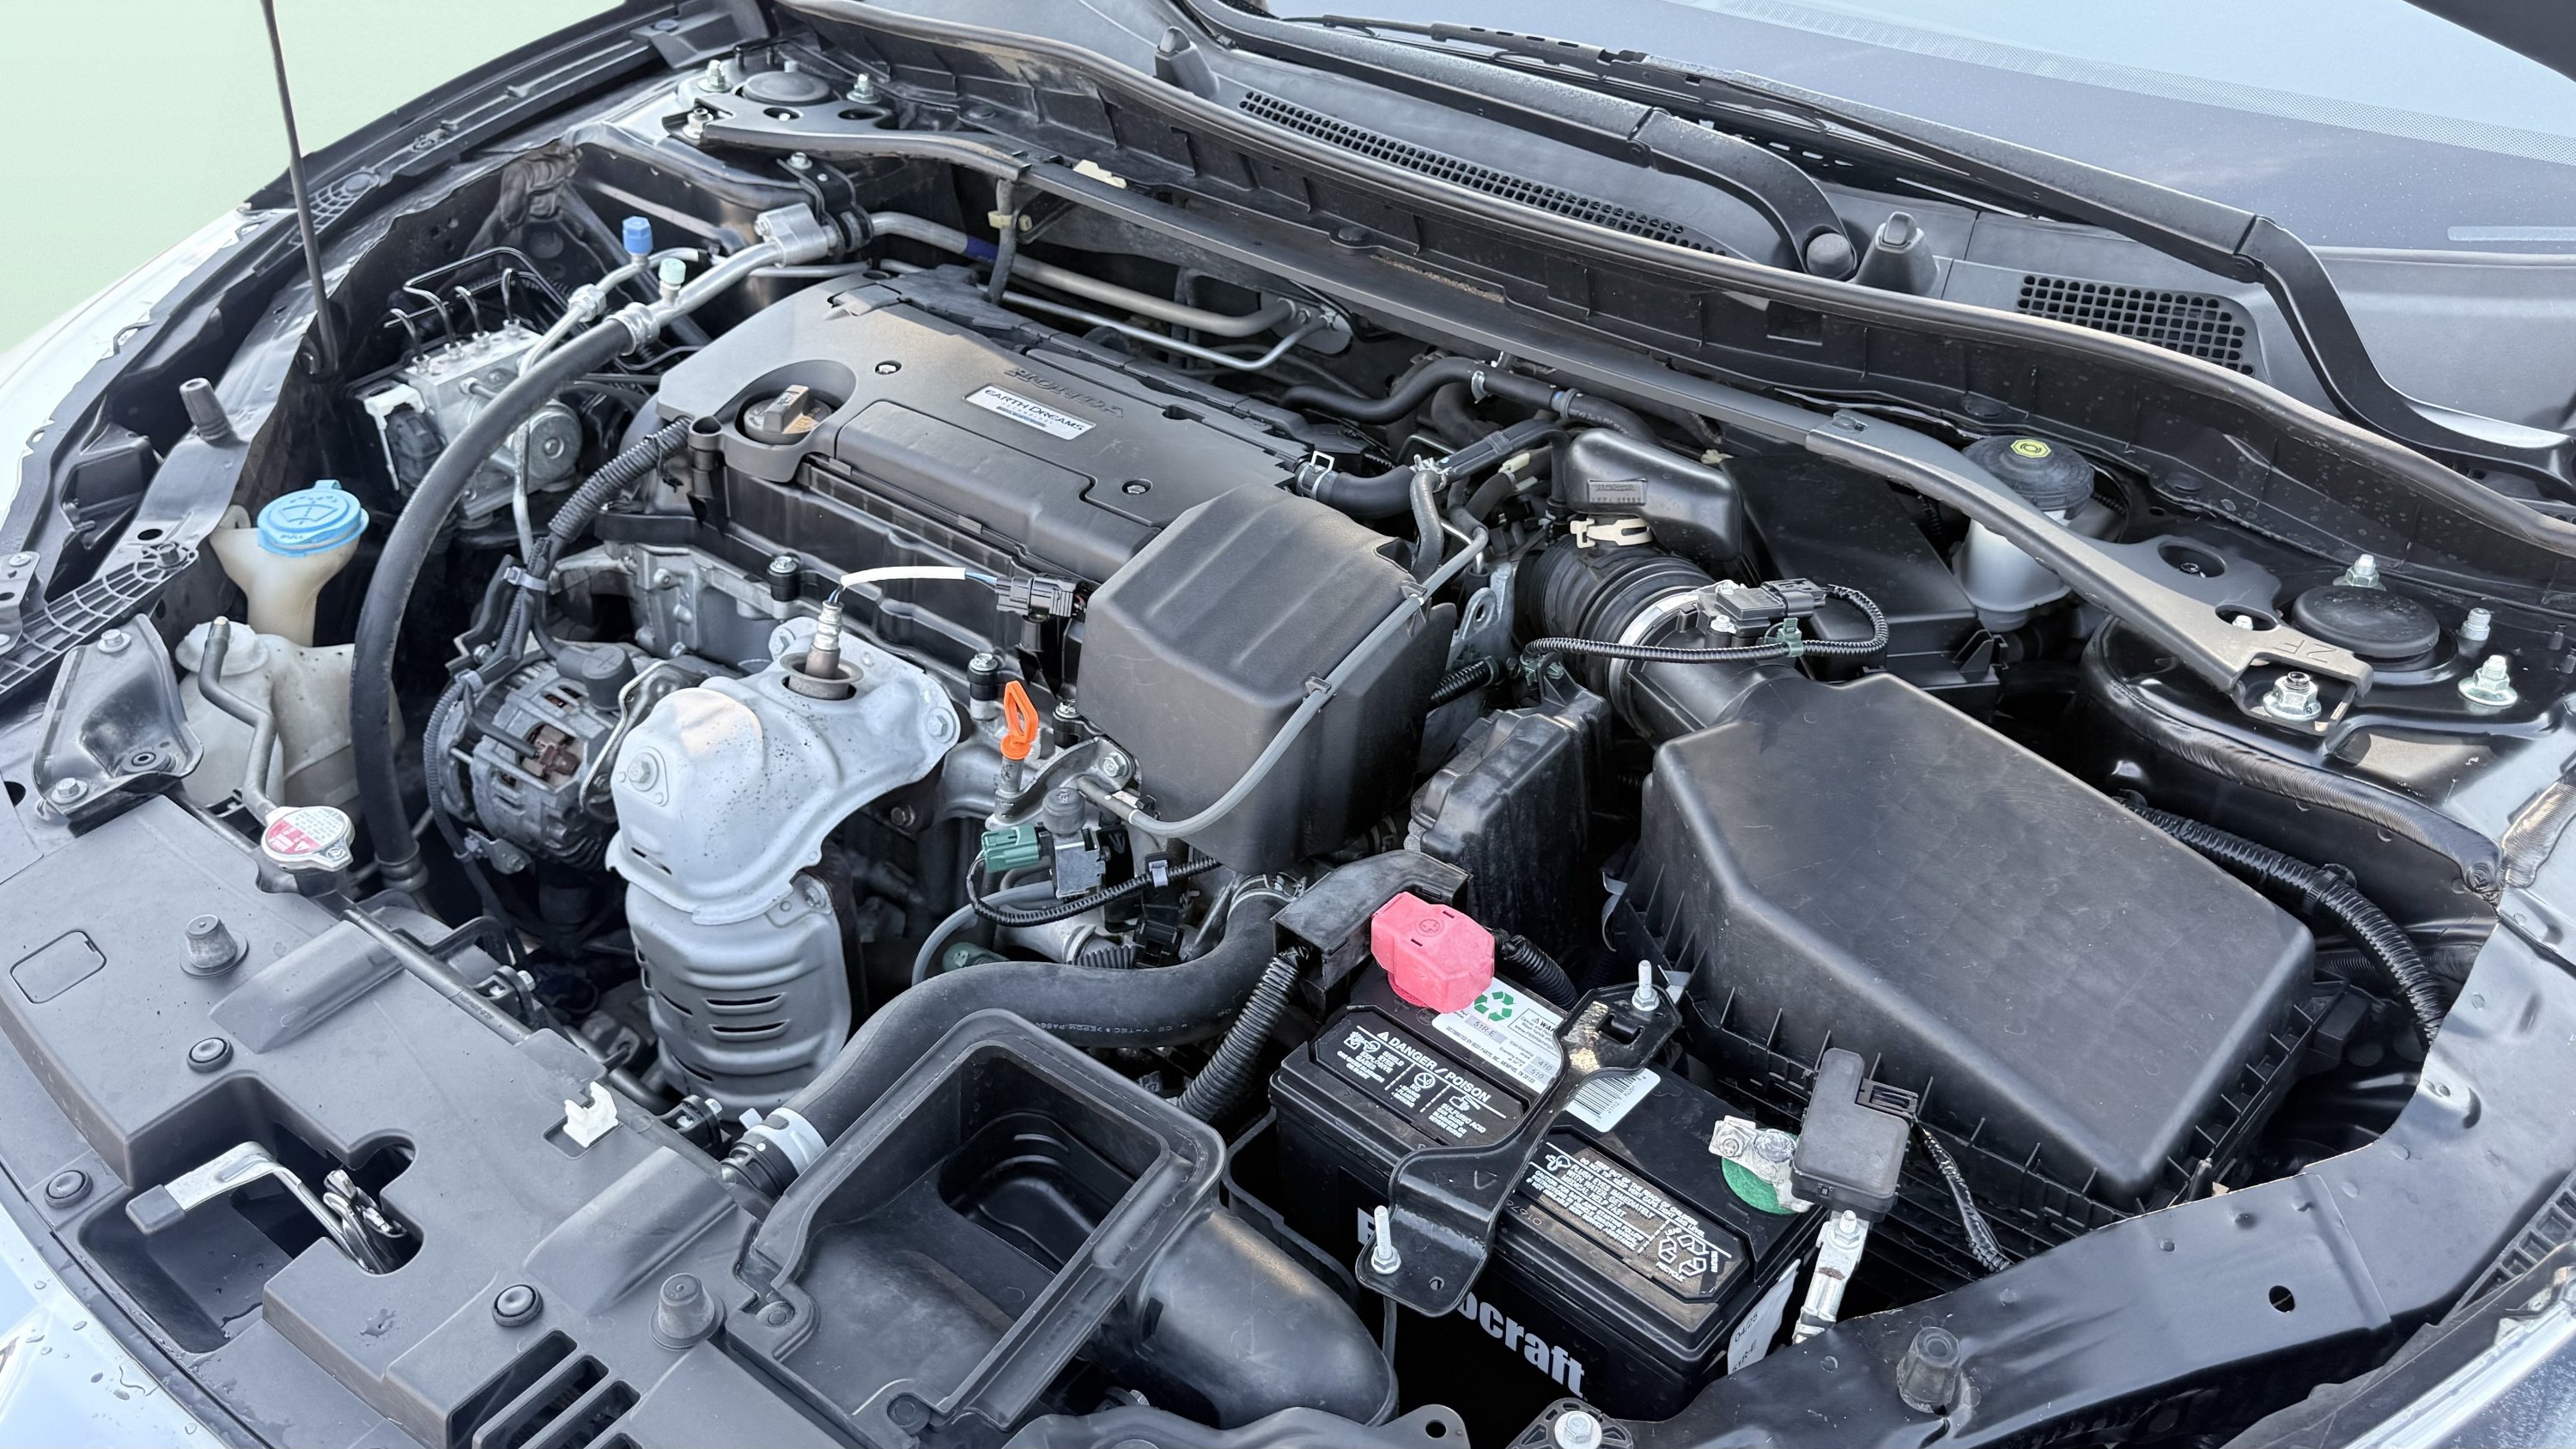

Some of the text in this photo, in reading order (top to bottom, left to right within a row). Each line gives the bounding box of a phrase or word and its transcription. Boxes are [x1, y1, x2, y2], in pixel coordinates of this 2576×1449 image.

[985, 389, 1027, 410] EARTH
[1029, 405, 1084, 430] DREAMS
[1473, 1020, 1497, 1038] 51R-E
[1359, 1050, 1393, 1074] EXPLOSIVE
[1530, 1068, 1544, 1079] 510
[1538, 1059, 1552, 1071] 410
[1409, 1083, 1421, 1092] NO
[1441, 1103, 1486, 1134] SULFURIC ACID
[1531, 1181, 1544, 1190] NOT
[1560, 1174, 1627, 1217] MEDICAL HELP FAST
[1566, 1169, 1584, 1184] WITH
[1608, 1196, 1625, 1207] GET
[1571, 1164, 1656, 1219] FLUSH EYES IMMEDIATELY
[1589, 1162, 1602, 1172] NOT
[1613, 1178, 1628, 1188] KEEP
[1627, 1186, 1643, 1197] VENT
[1642, 1196, 1658, 1208] CAPS
[1658, 1204, 1676, 1218] TIGHT
[1674, 1216, 1688, 1227] AND
[1594, 1160, 1610, 1170] KEEP
[1609, 1169, 1622, 1178] OUT
[1631, 1182, 1643, 1191] THE
[1641, 1189, 1662, 1203] REACH
[1667, 1206, 1698, 1227] CHILDREN
[1557, 1184, 1570, 1194] FOR
[1568, 1191, 1583, 1202] SAFE
[1581, 1201, 1597, 1211] JUMP
[1595, 1209, 1622, 1227] STARTING
[1621, 1225, 1644, 1240] FOLLOW
[1656, 1261, 1686, 1282] RECYCLE
